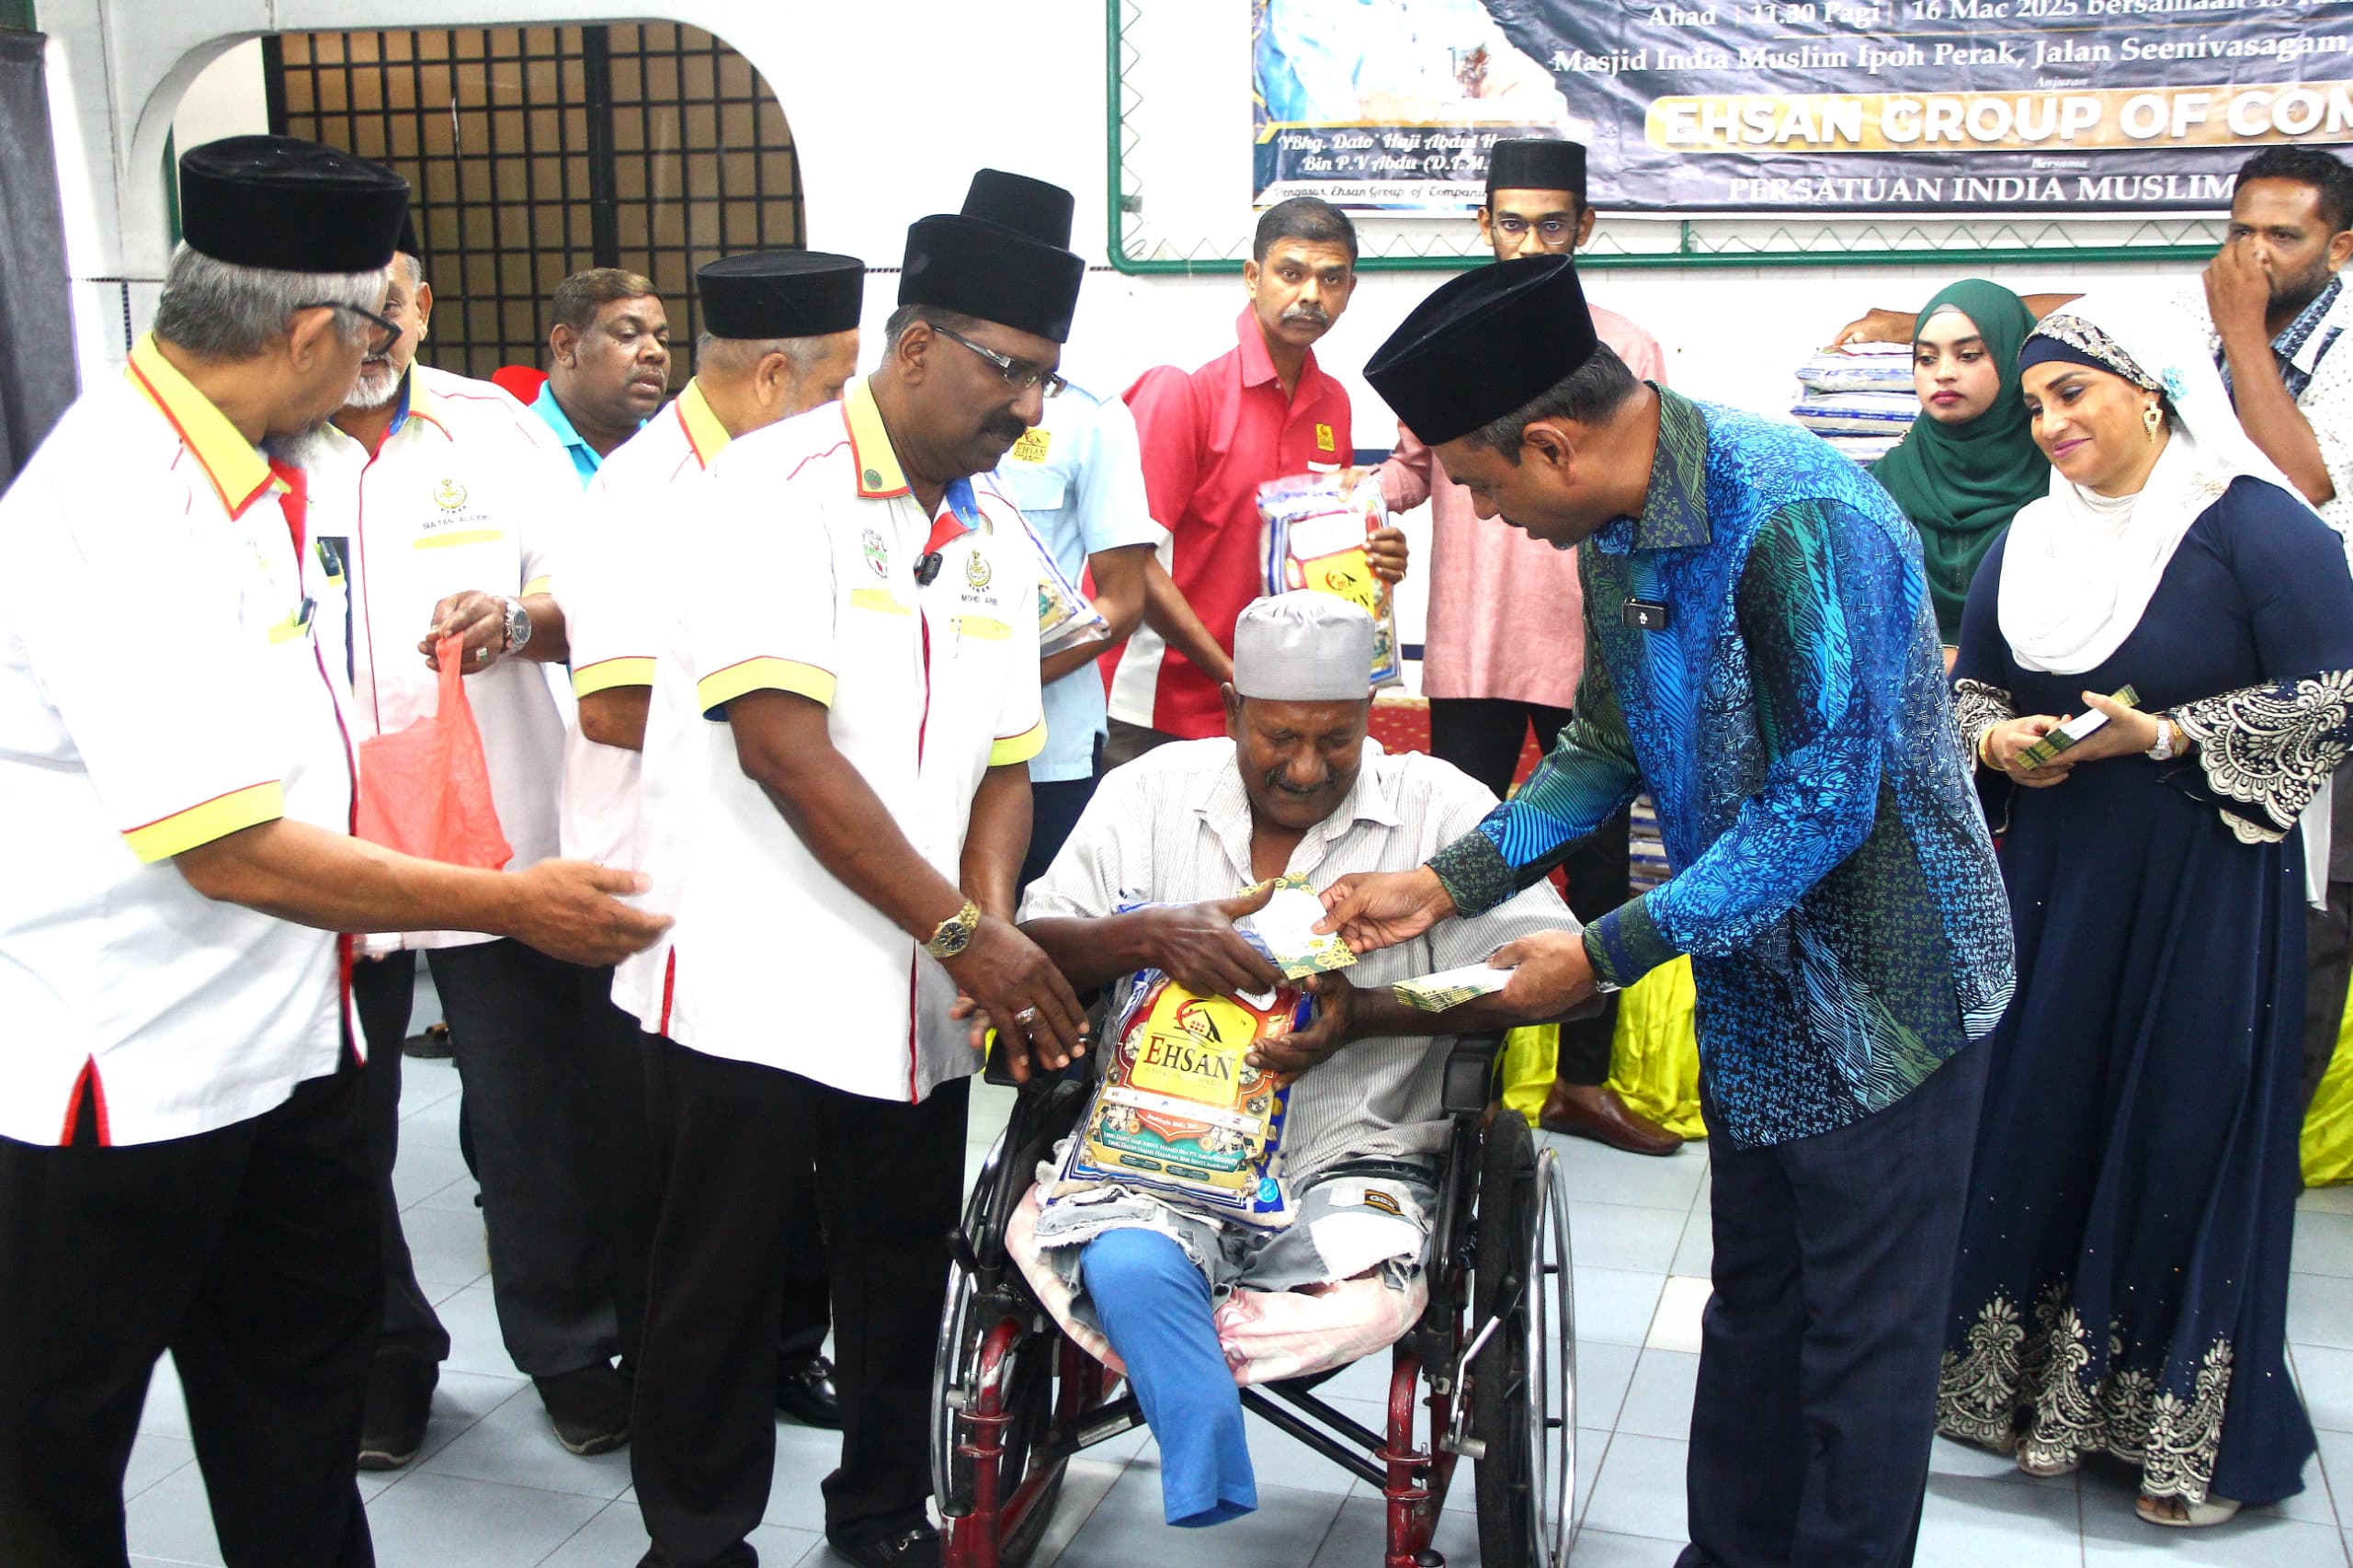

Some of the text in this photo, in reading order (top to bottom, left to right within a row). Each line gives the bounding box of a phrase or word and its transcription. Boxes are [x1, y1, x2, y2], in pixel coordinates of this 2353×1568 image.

[1648, 6, 1717, 27] Ahad
[1749, 3, 1816, 25] 11.30
[1824, 1, 1881, 28] Pagi
[1912, 0, 1941, 21] 16
[1949, 0, 2009, 19] Mac
[2016, 0, 2078, 17] 2025
[1552, 49, 1648, 77] Masjid
[1654, 47, 1729, 71] India
[1738, 44, 1848, 70] Muslim
[1857, 43, 1926, 75] Ipoh
[1933, 41, 2026, 69] Perak,
[2031, 39, 2111, 69] Jalan
[2034, 75, 2089, 90] Anjuran
[1665, 96, 1863, 144] EHSAN
[1881, 96, 2103, 143] GROUP
[2120, 93, 2211, 139] OF
[1382, 133, 1421, 153] Haji
[1425, 133, 1478, 150] Abdul
[1302, 155, 1333, 172] Bin
[1370, 155, 1417, 172] Abdu
[2030, 155, 2089, 171] Bersama
[1727, 174, 2238, 203] PERSATUAN INDIA MUSLIM
[1014, 442, 1046, 457] EHSAN
[1142, 1035, 1236, 1081] EHSAN
